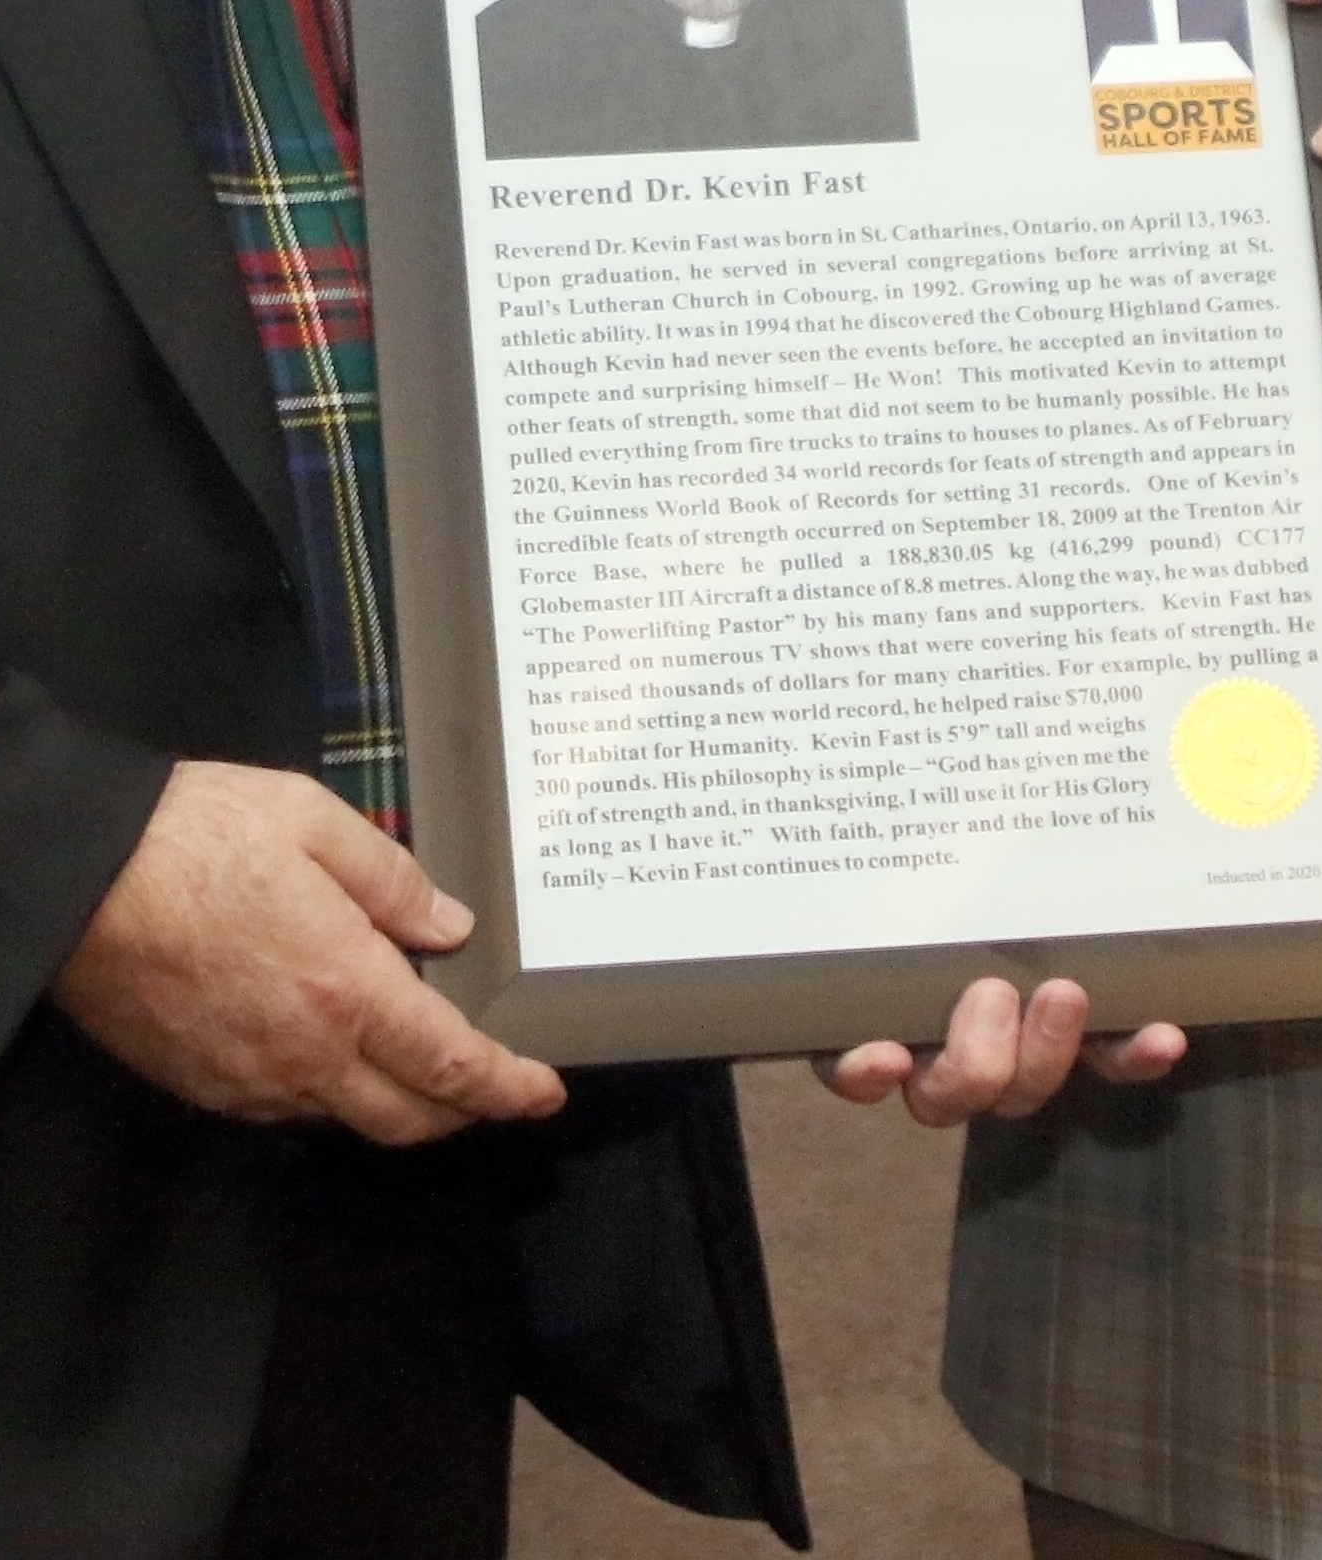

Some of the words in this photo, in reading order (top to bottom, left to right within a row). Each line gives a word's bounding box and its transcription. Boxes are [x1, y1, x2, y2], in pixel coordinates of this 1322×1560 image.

[1098, 98, 1256, 131] SPORTS
[1103, 132, 1158, 148] HALL
[1164, 130, 1192, 145] OF
[1199, 127, 1258, 144] FAME
[488, 179, 633, 209] Reverend
[644, 177, 691, 202] Dr.
[701, 172, 790, 200] Kevin
[801, 170, 866, 195] Fast
[493, 238, 591, 260] Reverend
[594, 237, 627, 255] Dr.
[630, 234, 691, 254] Kevin
[694, 233, 739, 251] Fast
[742, 234, 781, 247] was
[784, 229, 832, 247] born
[836, 227, 856, 244] in
[860, 225, 887, 243] St.
[890, 221, 1009, 242] Catharines,
[1011, 216, 1097, 235] Ontario,
[1100, 218, 1125, 231] on
[1129, 211, 1182, 234] April
[1186, 210, 1215, 229] 13,
[1219, 207, 1270, 226] 1963.
[495, 271, 551, 293] Upon
[560, 265, 680, 291] graduation,
[687, 262, 713, 280] he
[721, 258, 788, 278] served
[796, 257, 817, 275] in
[825, 253, 897, 274] several
[905, 247, 1046, 272] congregations
[1054, 243, 1118, 262] before
[1127, 240, 1210, 260] arriving
[1218, 239, 1237, 255] at
[1246, 236, 1273, 253] St.
[500, 327, 576, 347] athletic
[579, 324, 651, 345] ability.
[653, 321, 672, 340] It
[675, 324, 715, 338] was
[718, 319, 738, 337] in
[743, 316, 791, 336] 1994
[793, 315, 836, 333] that
[839, 314, 864, 331] he
[867, 307, 975, 330] discovered
[978, 306, 1011, 324] the
[1013, 304, 1104, 324] Cobourg
[1107, 296, 1201, 321] Highland
[1204, 295, 1280, 313] Games.
[503, 355, 598, 378] Although
[602, 352, 665, 372] Kevin
[670, 349, 710, 369] had
[715, 351, 773, 367] never
[777, 348, 821, 364] seen
[826, 343, 859, 361] the
[863, 341, 928, 359] events
[932, 337, 1003, 356] before,
[1007, 335, 1032, 352] he
[1037, 329, 1125, 353] accepted
[1131, 332, 1155, 346] an
[1160, 324, 1258, 345] invitation
[1262, 324, 1283, 339] to
[506, 417, 562, 436] other
[565, 415, 616, 433] feats
[618, 411, 643, 430] of
[646, 408, 738, 431] strength,
[743, 409, 795, 424] some
[800, 403, 842, 421] that
[847, 400, 880, 419] did
[886, 400, 919, 417] not
[924, 400, 975, 415] seem
[980, 396, 1000, 412] to
[1004, 393, 1030, 411] be
[1034, 388, 1124, 410] humanly
[1129, 383, 1216, 410] possible.
[1221, 382, 1249, 400] He
[1255, 381, 1289, 398] has
[510, 475, 566, 496] 2020,
[569, 472, 632, 492] Kevin
[636, 471, 672, 489] has
[677, 465, 768, 487] recorded
[773, 463, 797, 482] 34
[801, 460, 862, 479] world
[867, 456, 944, 477] records
[947, 455, 979, 473] for
[982, 453, 1031, 471] feats
[1034, 450, 1057, 468] of
[1059, 446, 1144, 468] strength
[1148, 443, 1186, 462] and
[1191, 444, 1271, 464] appears
[1275, 438, 1295, 456] in
[515, 532, 619, 555] incredible
[623, 531, 673, 549] feats
[678, 528, 700, 547] of
[703, 524, 788, 547] strength
[793, 518, 885, 541] occurred
[890, 521, 915, 535] on
[920, 512, 1031, 538] September
[1035, 509, 1066, 529] 18,
[1070, 506, 1118, 526] 2009
[1123, 507, 1143, 523] at
[1146, 503, 1180, 521] the
[1183, 501, 1265, 520] Trenton
[1270, 497, 1303, 515] Air
[524, 652, 621, 680] appeared
[628, 656, 654, 670] on
[659, 649, 764, 668] numerous
[768, 642, 802, 662] TV
[808, 641, 871, 660] shows
[876, 637, 919, 656] that
[924, 638, 974, 653] were
[979, 629, 1069, 651] covering
[1073, 626, 1103, 645] his
[1109, 625, 1158, 643] feats
[1163, 621, 1185, 640] of
[1190, 616, 1280, 641] strength.
[1286, 615, 1315, 633] He
[527, 688, 562, 705] has
[569, 682, 632, 703] raised
[638, 676, 745, 699] thousands
[751, 674, 773, 693] of
[778, 672, 849, 692] dollars
[855, 669, 887, 688] for
[892, 669, 950, 687] many
[956, 660, 1051, 682] charities.
[1056, 658, 1094, 676] For
[1098, 652, 1192, 676] example,
[1196, 650, 1223, 672] by
[1228, 646, 1301, 671] pulling
[1305, 648, 1318, 662] a
[529, 718, 589, 735] house
[593, 712, 632, 732] and
[635, 709, 707, 732] setting
[708, 712, 722, 726] a
[724, 709, 766, 725] new
[769, 701, 831, 722] world
[834, 697, 910, 719] record,
[912, 696, 937, 714] he
[939, 691, 1009, 716] helped
[1011, 690, 1061, 709] raise
[1064, 684, 1143, 706] $70,000
[1205, 867, 1266, 885] Inducted
[1268, 868, 1284, 881] in
[1285, 864, 1322, 880] 2020
